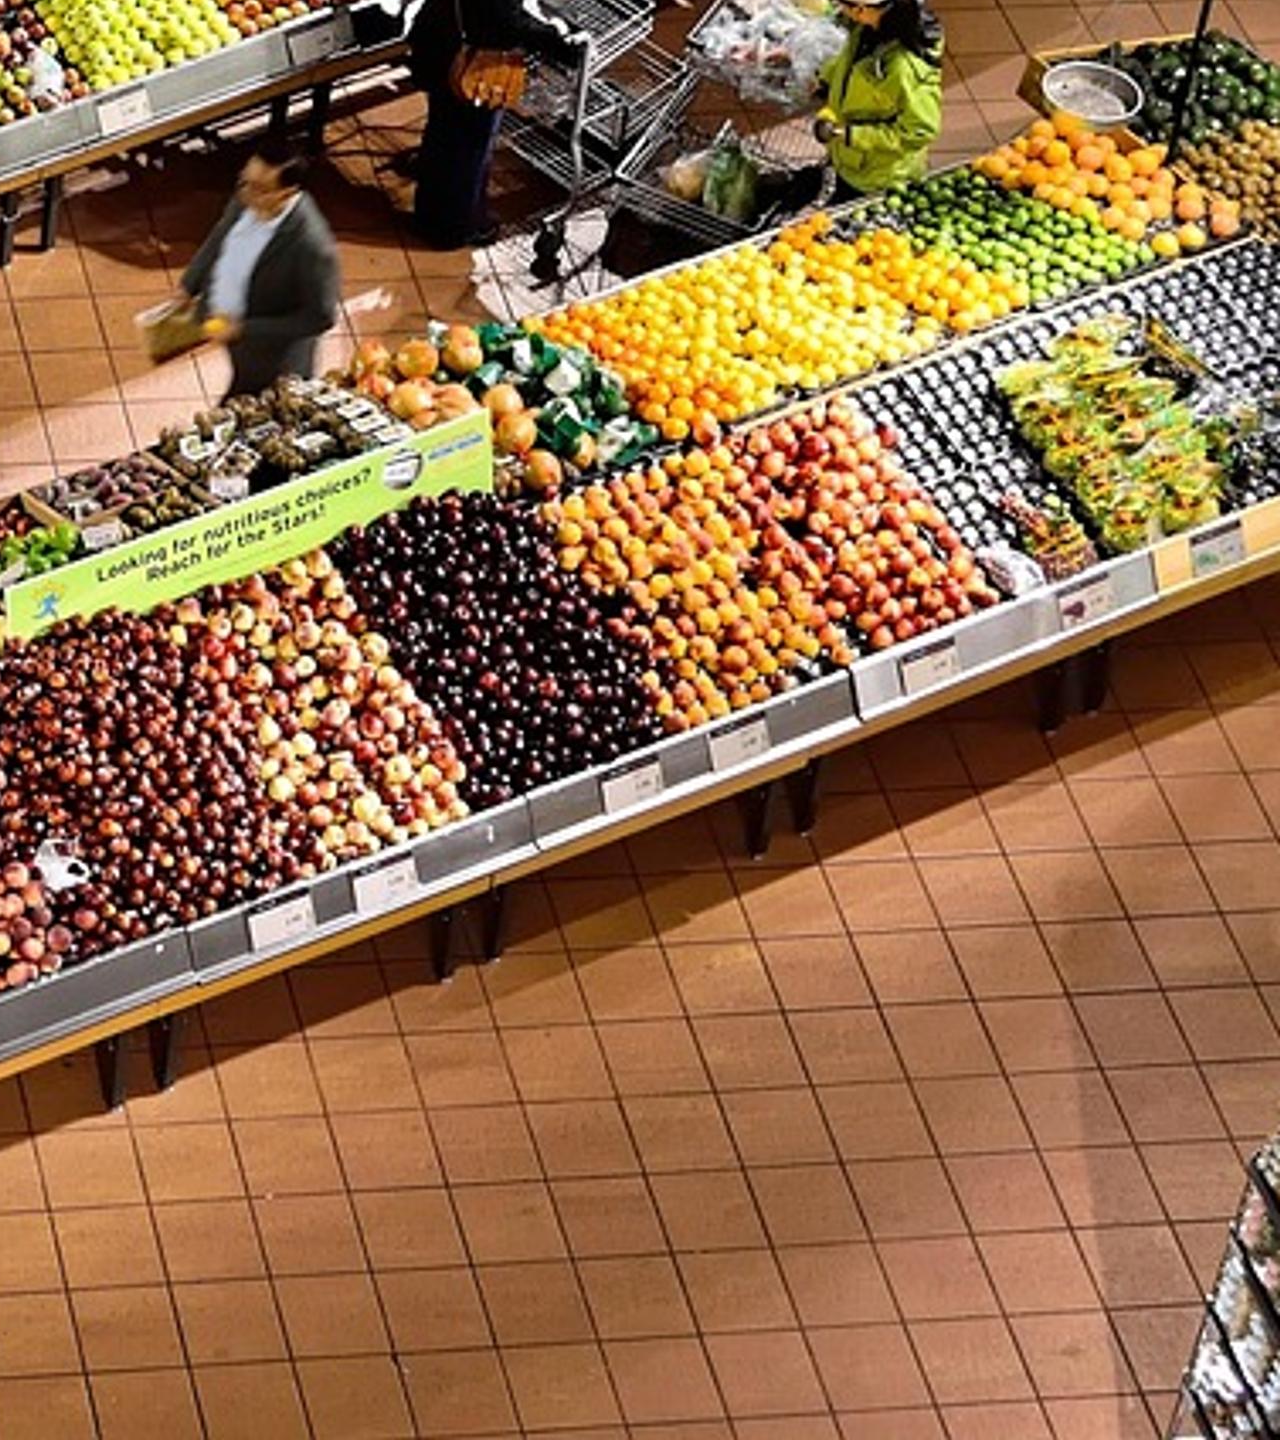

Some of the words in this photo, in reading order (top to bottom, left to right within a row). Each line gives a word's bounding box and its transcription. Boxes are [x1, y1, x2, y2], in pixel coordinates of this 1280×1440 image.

[96, 547, 168, 582] Looking
[172, 531, 198, 552] for
[202, 501, 290, 541] nutritious
[296, 467, 372, 509] choices?
[145, 549, 202, 582] Reach
[207, 540, 231, 560] for
[237, 526, 267, 548] the
[272, 503, 326, 536] Stars!
